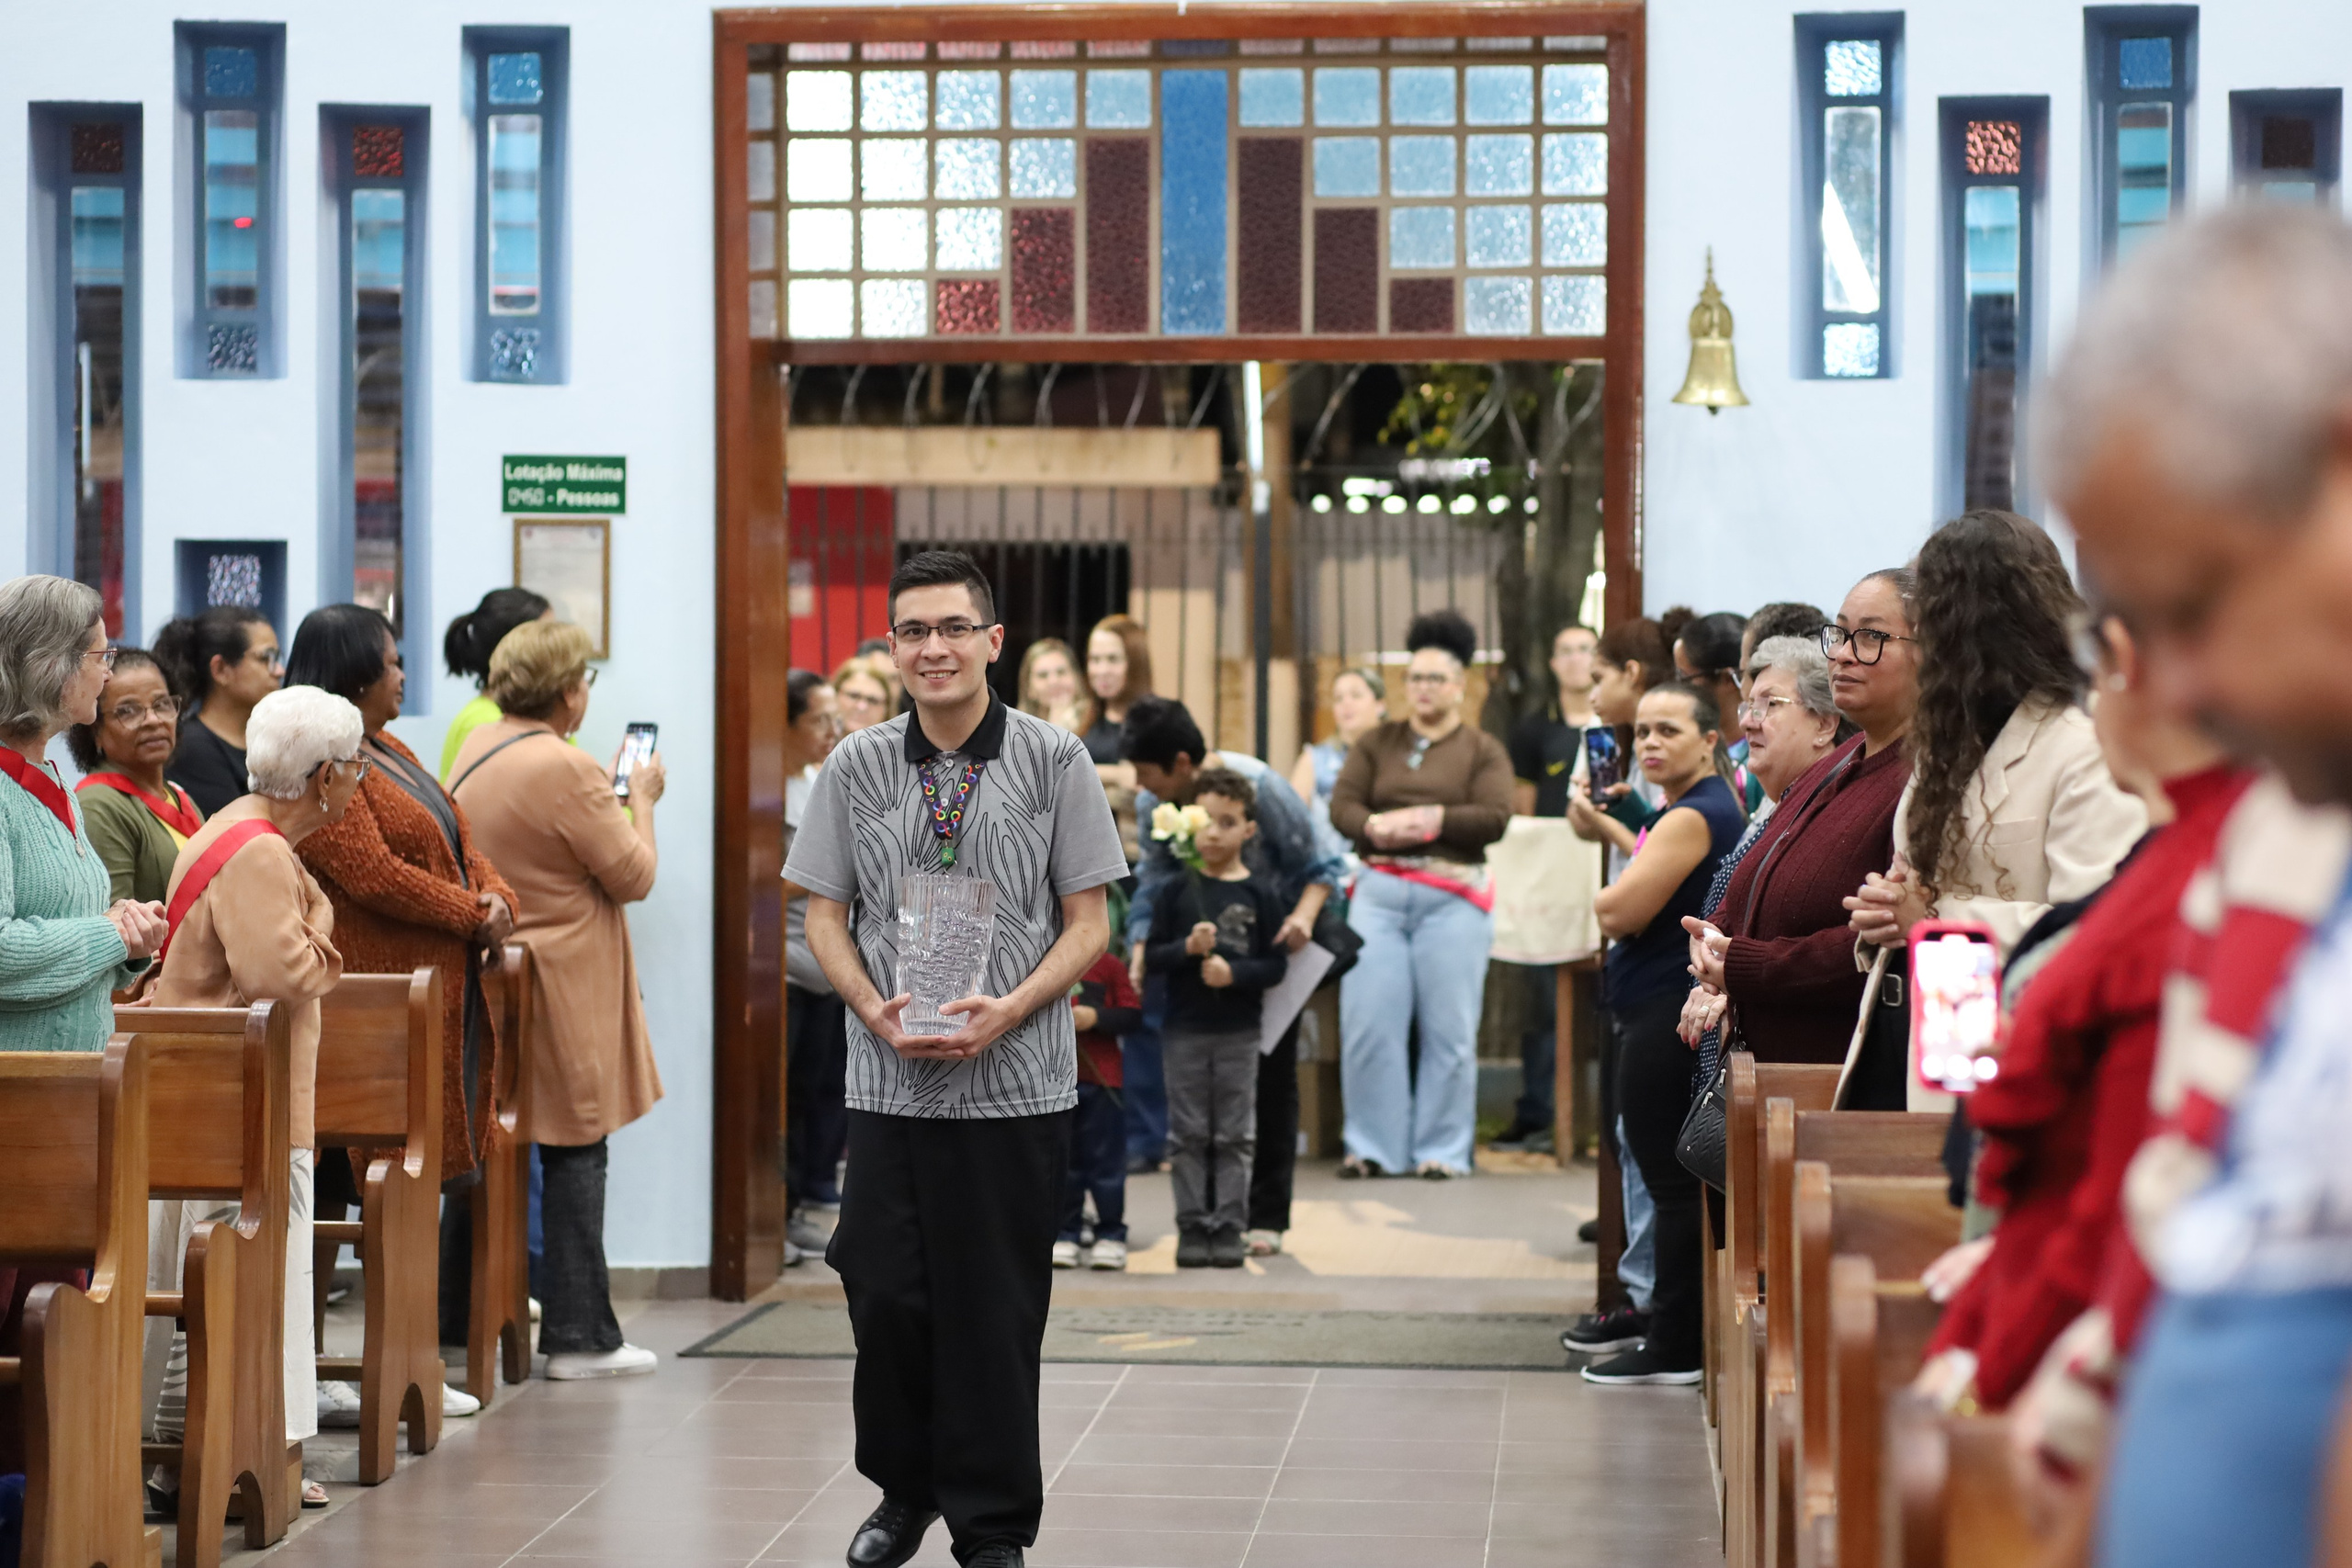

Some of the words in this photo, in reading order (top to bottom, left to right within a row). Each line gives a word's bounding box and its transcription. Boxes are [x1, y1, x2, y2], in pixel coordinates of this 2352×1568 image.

[505, 463, 564, 483] Lotação
[567, 463, 624, 481] Máxima
[557, 488, 620, 507] Pessoas
